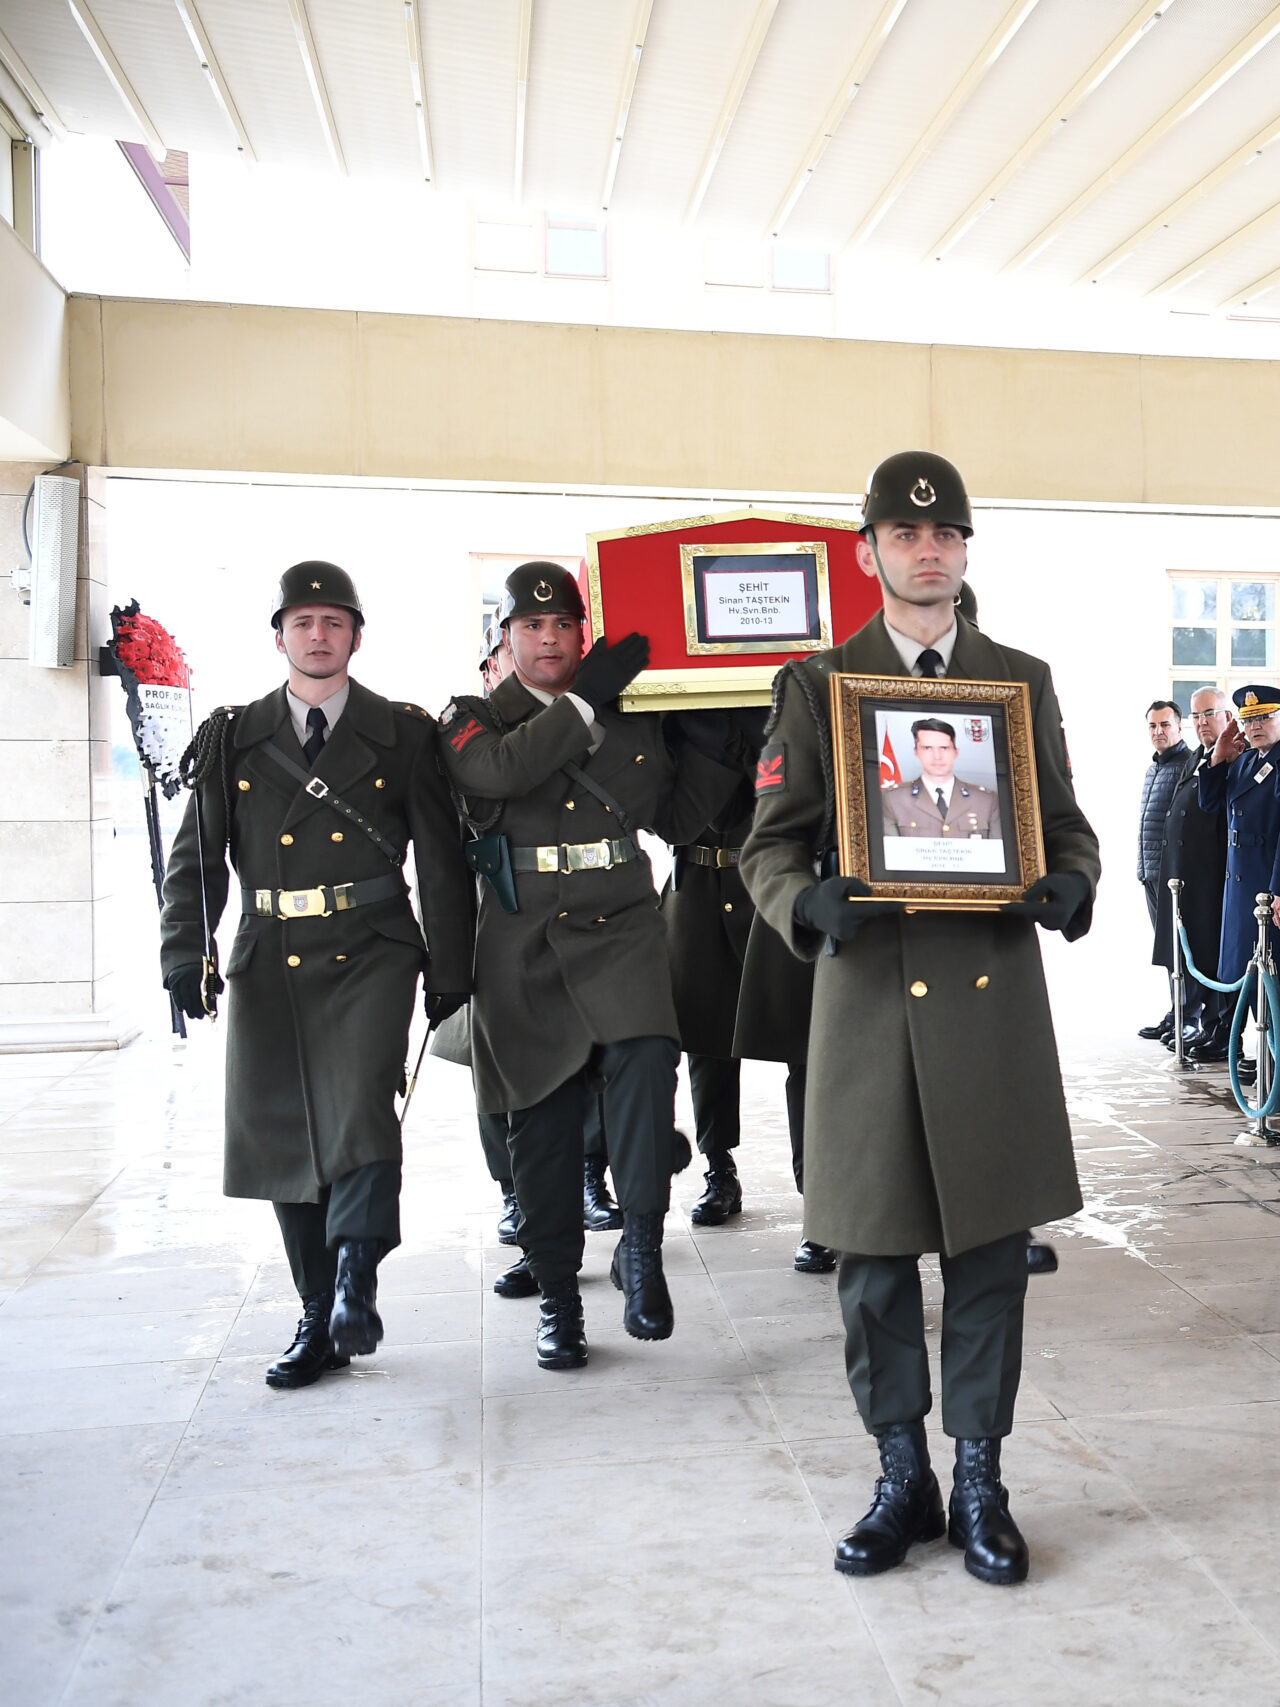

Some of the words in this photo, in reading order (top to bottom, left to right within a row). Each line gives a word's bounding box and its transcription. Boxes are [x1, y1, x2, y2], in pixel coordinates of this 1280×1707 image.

[739, 581, 769, 593] ŞEHİT
[719, 596, 743, 605] Sinan
[746, 595, 790, 604] TAŞTEKİN
[728, 606, 781, 615] Hv.Svn.Bnb.
[740, 617, 773, 625] 2010-13
[145, 689, 172, 701] PROF.
